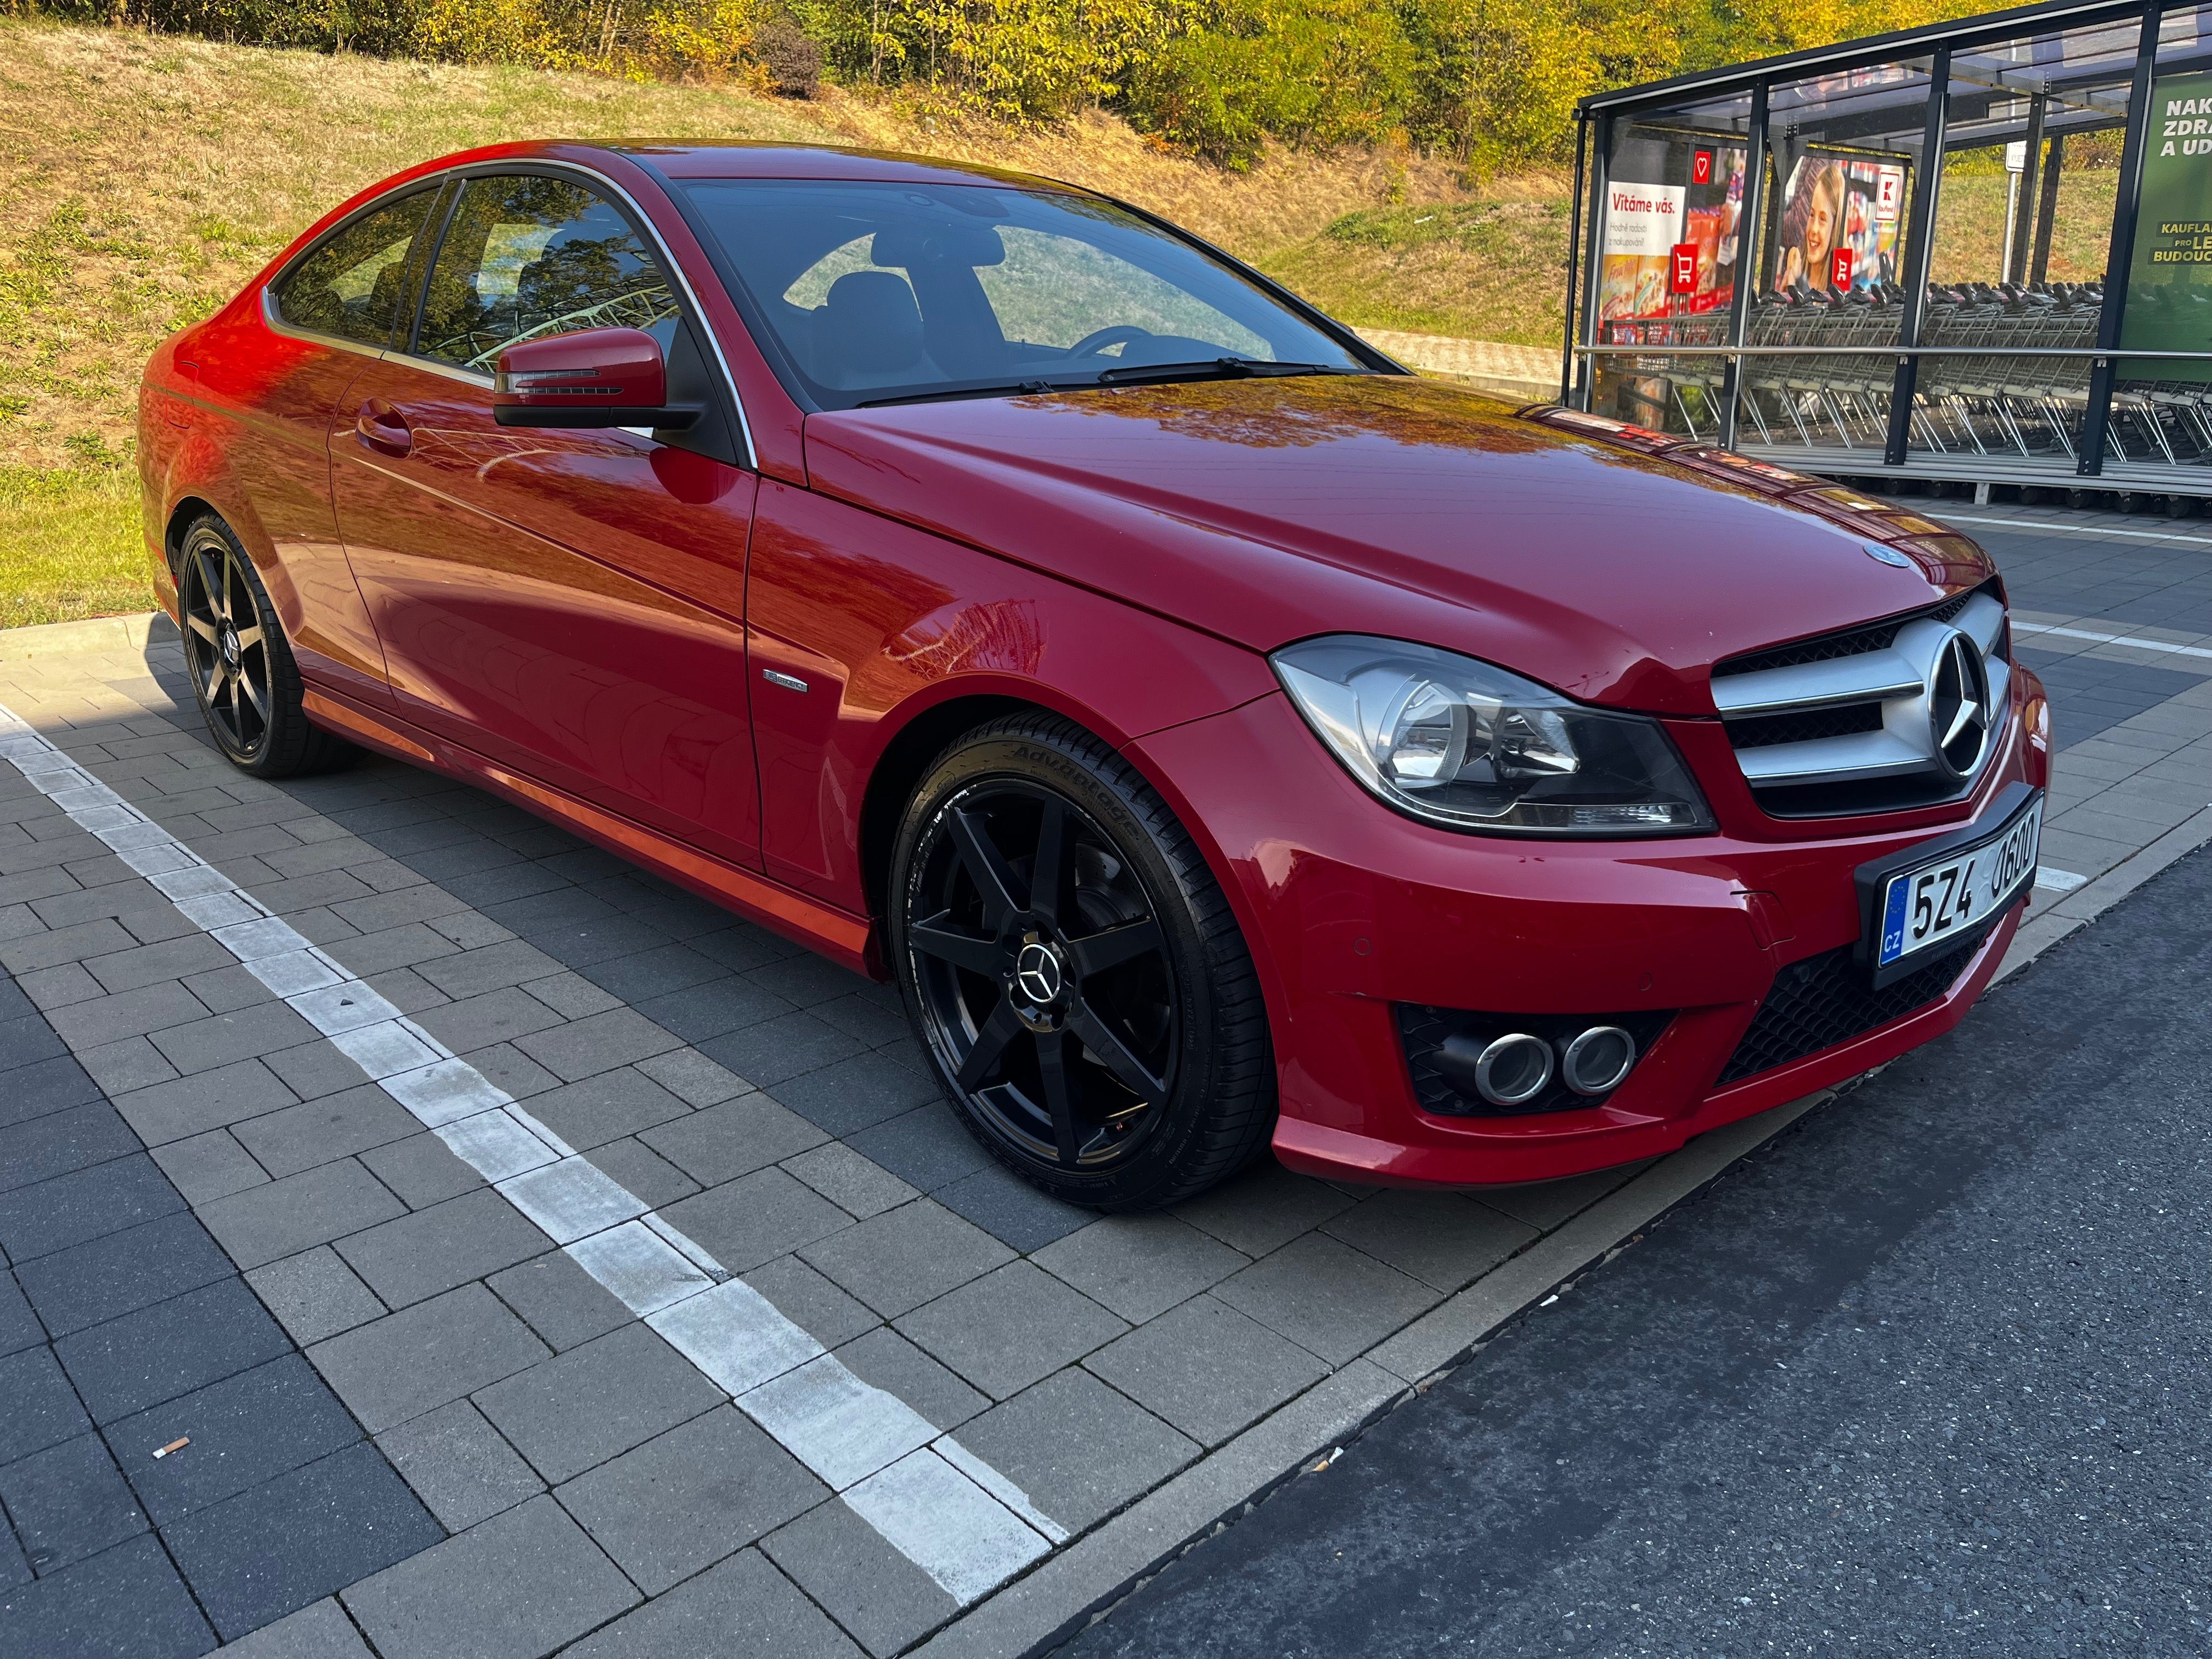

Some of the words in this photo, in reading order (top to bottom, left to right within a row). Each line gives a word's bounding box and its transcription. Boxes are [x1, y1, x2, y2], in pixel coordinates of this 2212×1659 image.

[2160, 140, 2176, 156] A
[1613, 193, 1652, 212] Vítáme
[1655, 197, 1675, 214] vás.
[2162, 223, 2212, 233] KAUFLA
[1013, 746, 1139, 838] Advantage
[1911, 858, 1976, 939] 5Z4
[1991, 811, 2034, 899] 0600
[1884, 930, 1901, 953] CZ
